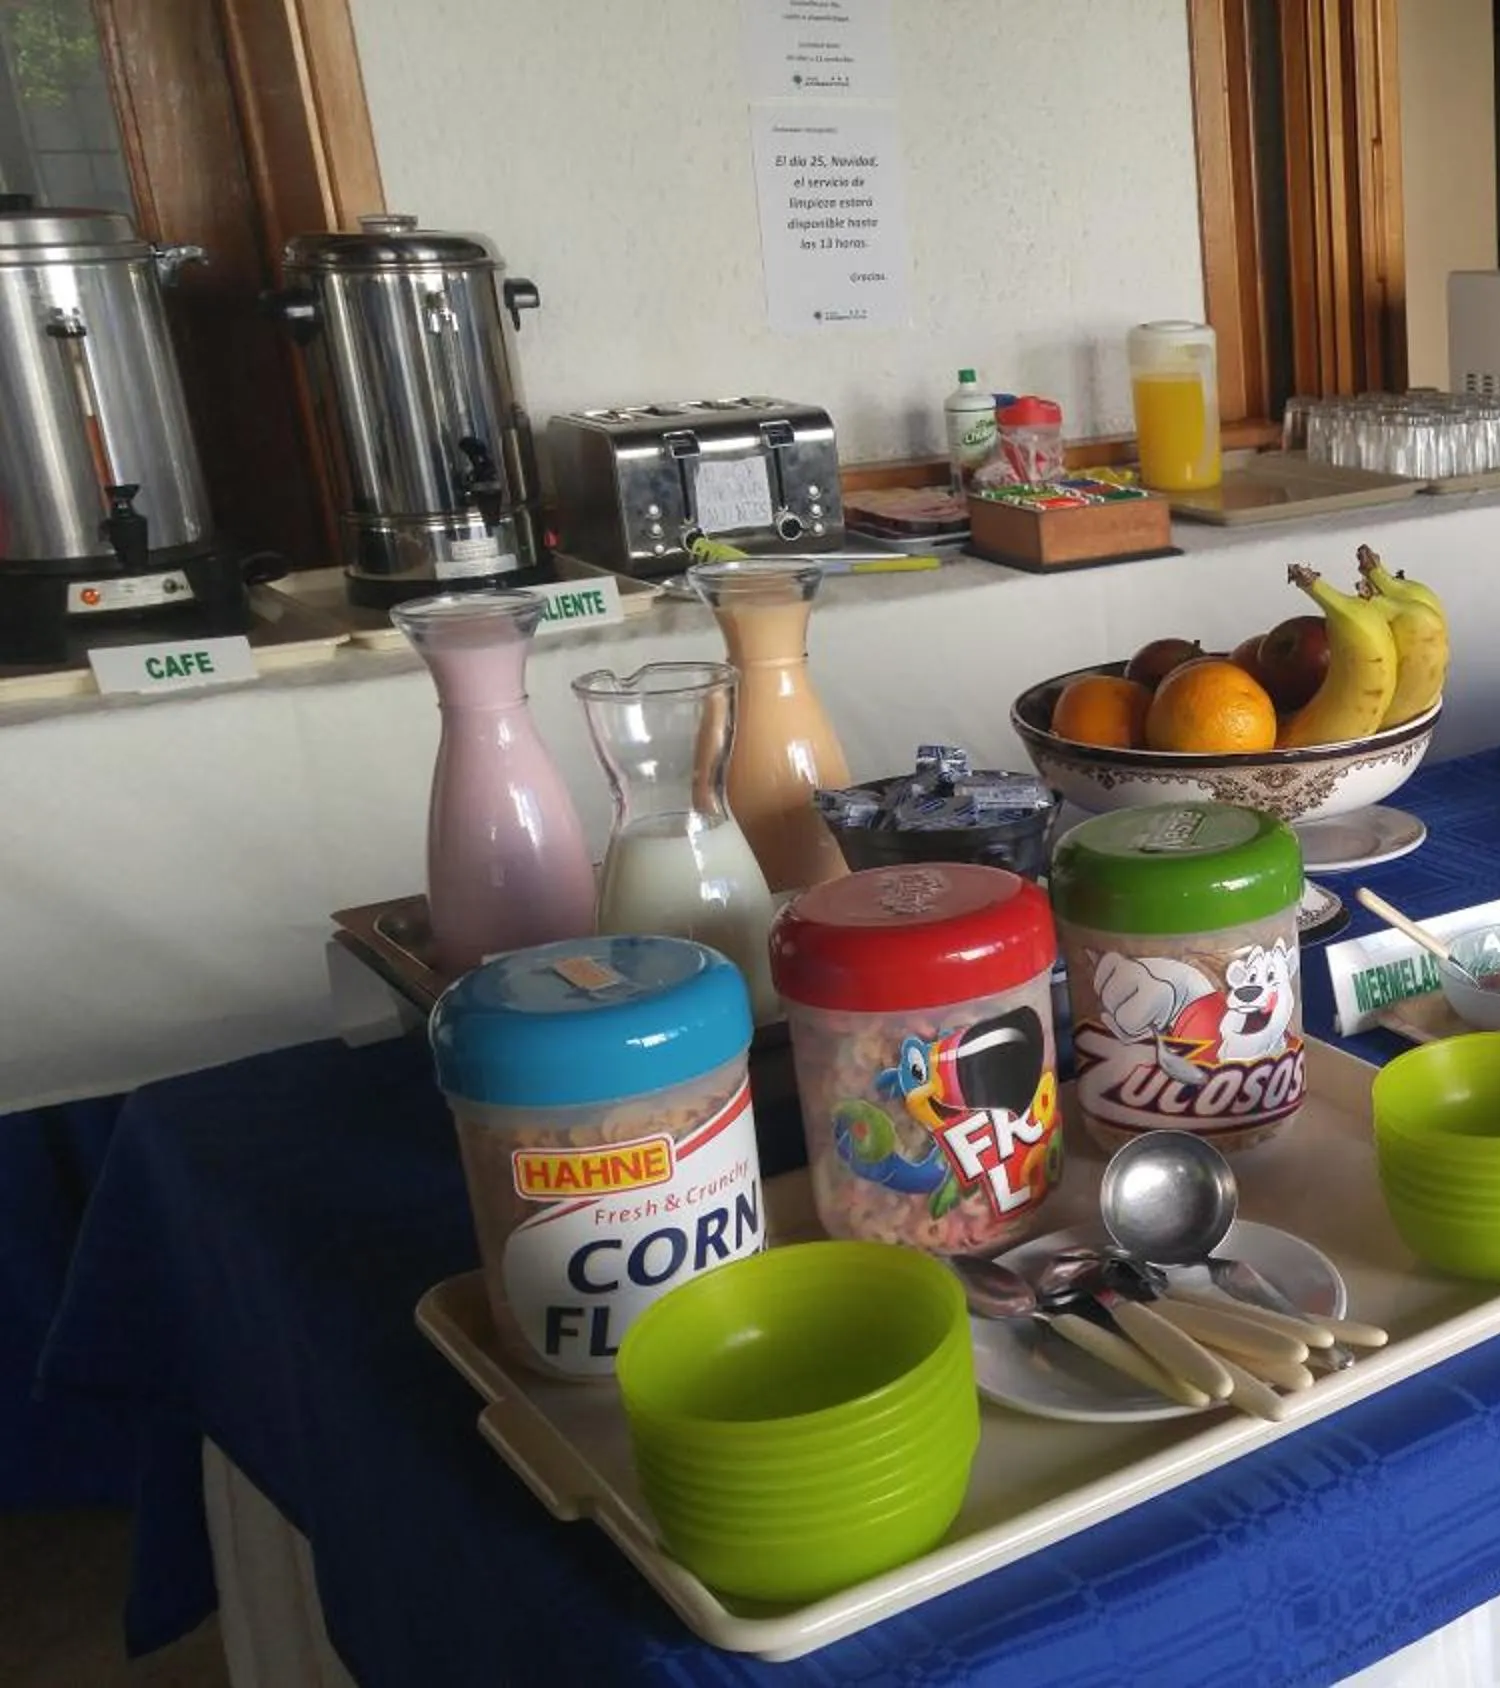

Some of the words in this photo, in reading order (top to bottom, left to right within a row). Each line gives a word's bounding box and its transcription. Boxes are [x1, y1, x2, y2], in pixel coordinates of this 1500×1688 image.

[775, 154, 787, 167] El
[793, 176, 805, 188] el
[808, 178, 849, 188] servicio
[851, 176, 865, 187] de
[789, 197, 837, 210] limpieza
[786, 217, 845, 231] disponible
[847, 218, 879, 229] hasta
[799, 238, 816, 250] las
[145, 651, 215, 680] CAFE
[523, 1147, 667, 1190] HAHNE
[594, 1198, 658, 1226] Fresh
[664, 1193, 681, 1213] &
[686, 1158, 749, 1204] Crunchy
[567, 1179, 759, 1295] CORN
